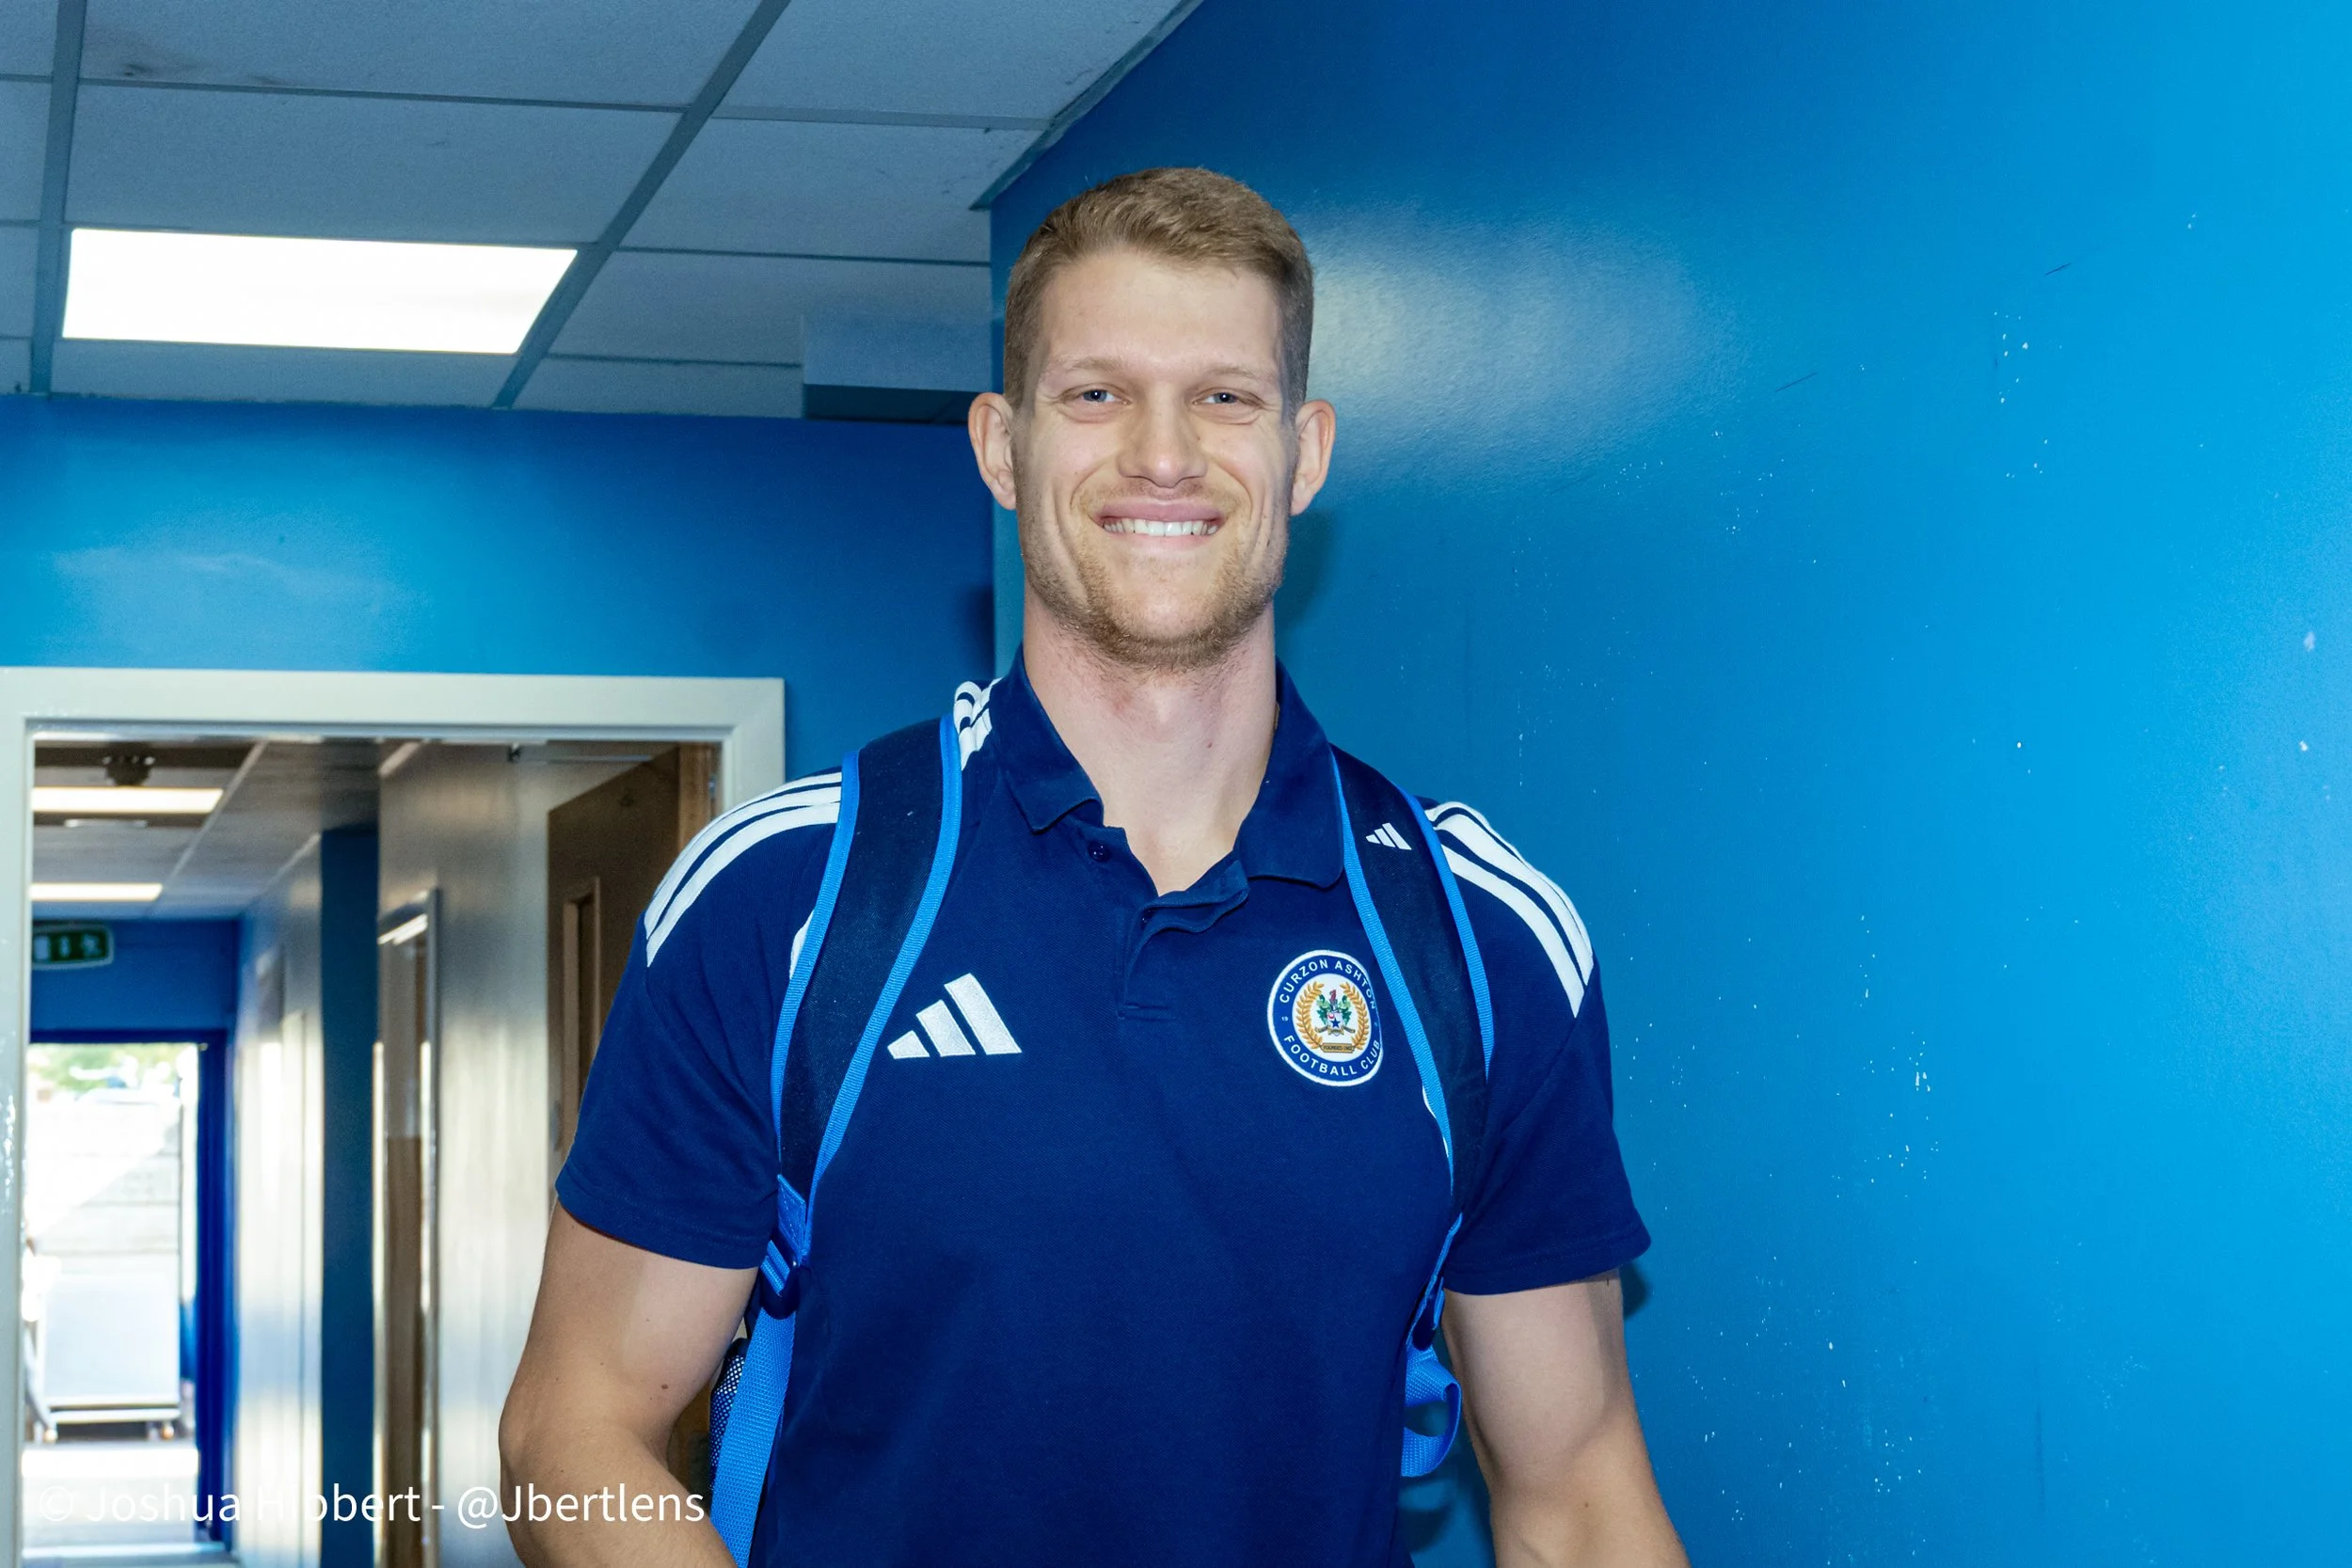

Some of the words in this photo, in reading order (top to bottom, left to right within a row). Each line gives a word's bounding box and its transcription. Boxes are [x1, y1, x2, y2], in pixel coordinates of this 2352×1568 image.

[1279, 959, 1327, 1003] CURZON
[1335, 960, 1375, 1009] ASHTON
[1284, 1035, 1357, 1076] FOOTBALL
[1360, 1040, 1380, 1069] CLUB
